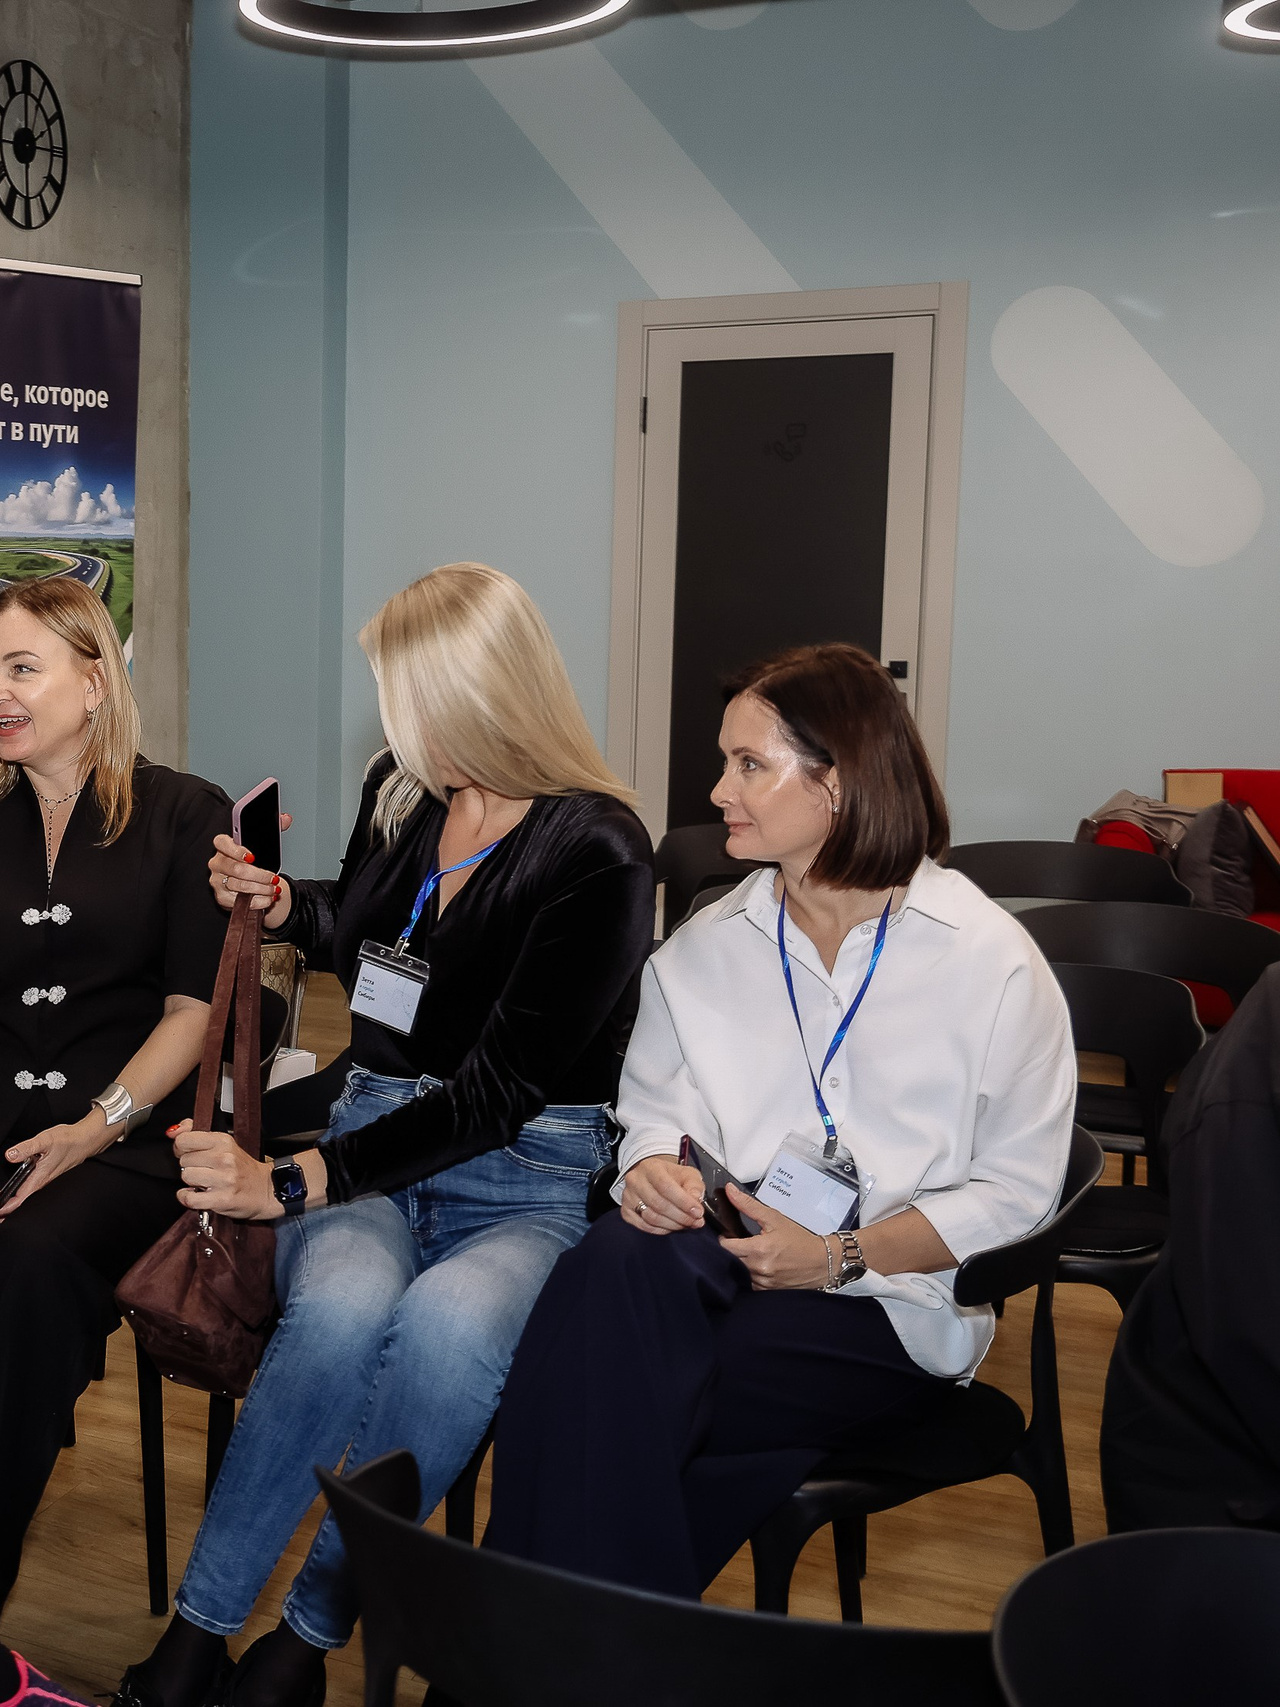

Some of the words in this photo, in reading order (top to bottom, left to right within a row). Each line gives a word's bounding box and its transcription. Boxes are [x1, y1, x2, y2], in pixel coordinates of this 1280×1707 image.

[25, 384, 109, 413] которое
[11, 422, 24, 441] в
[29, 423, 79, 448] пути
[768, 1181, 792, 1197] Сибири
